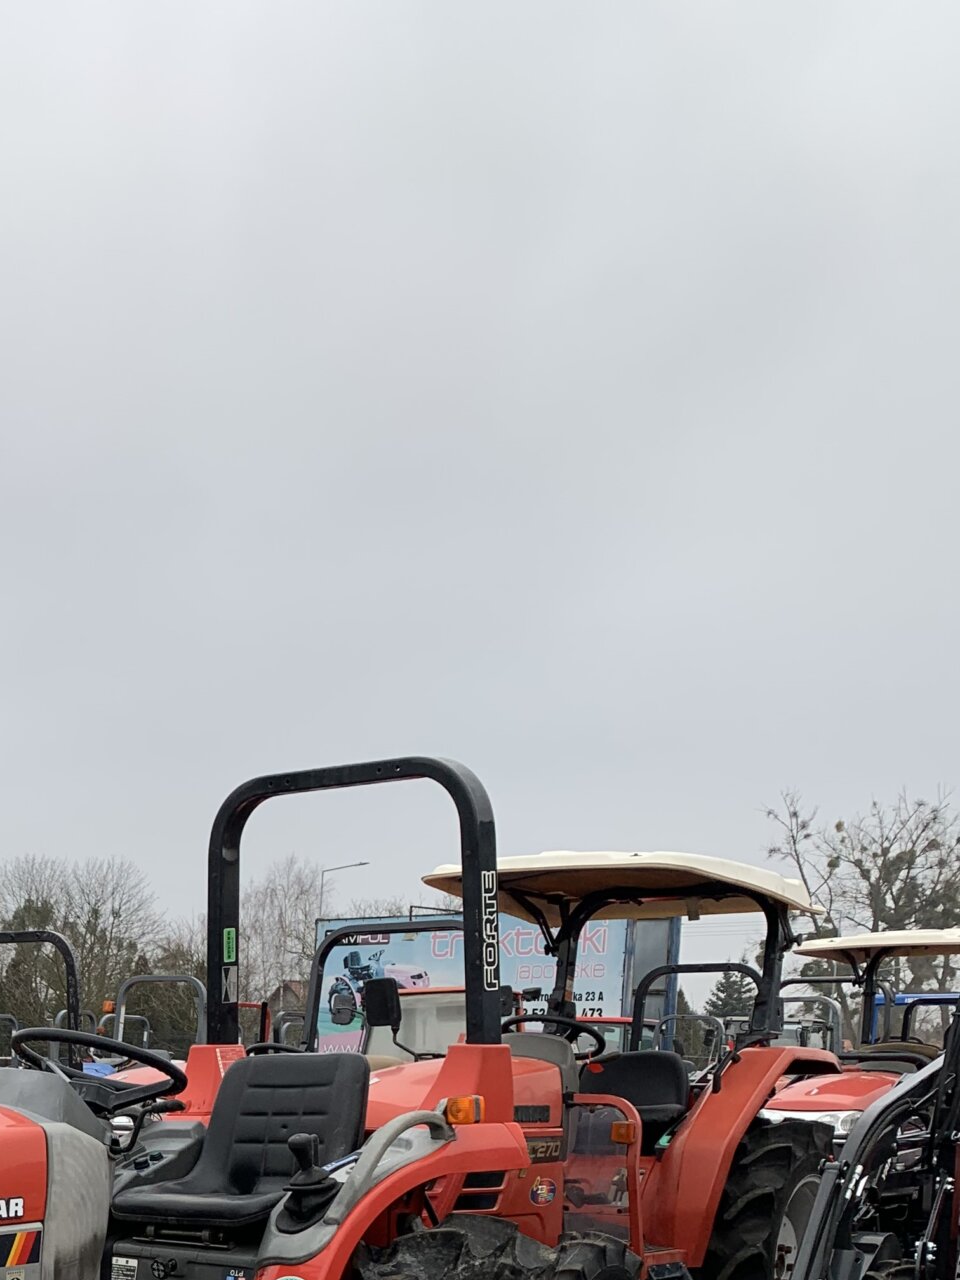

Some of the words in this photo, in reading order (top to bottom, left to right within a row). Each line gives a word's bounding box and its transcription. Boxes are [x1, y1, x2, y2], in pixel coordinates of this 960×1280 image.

[481, 871, 499, 991] FORTE
[515, 962, 605, 984] japoskie
[585, 991, 596, 1001] 23
[597, 991, 604, 1001] A
